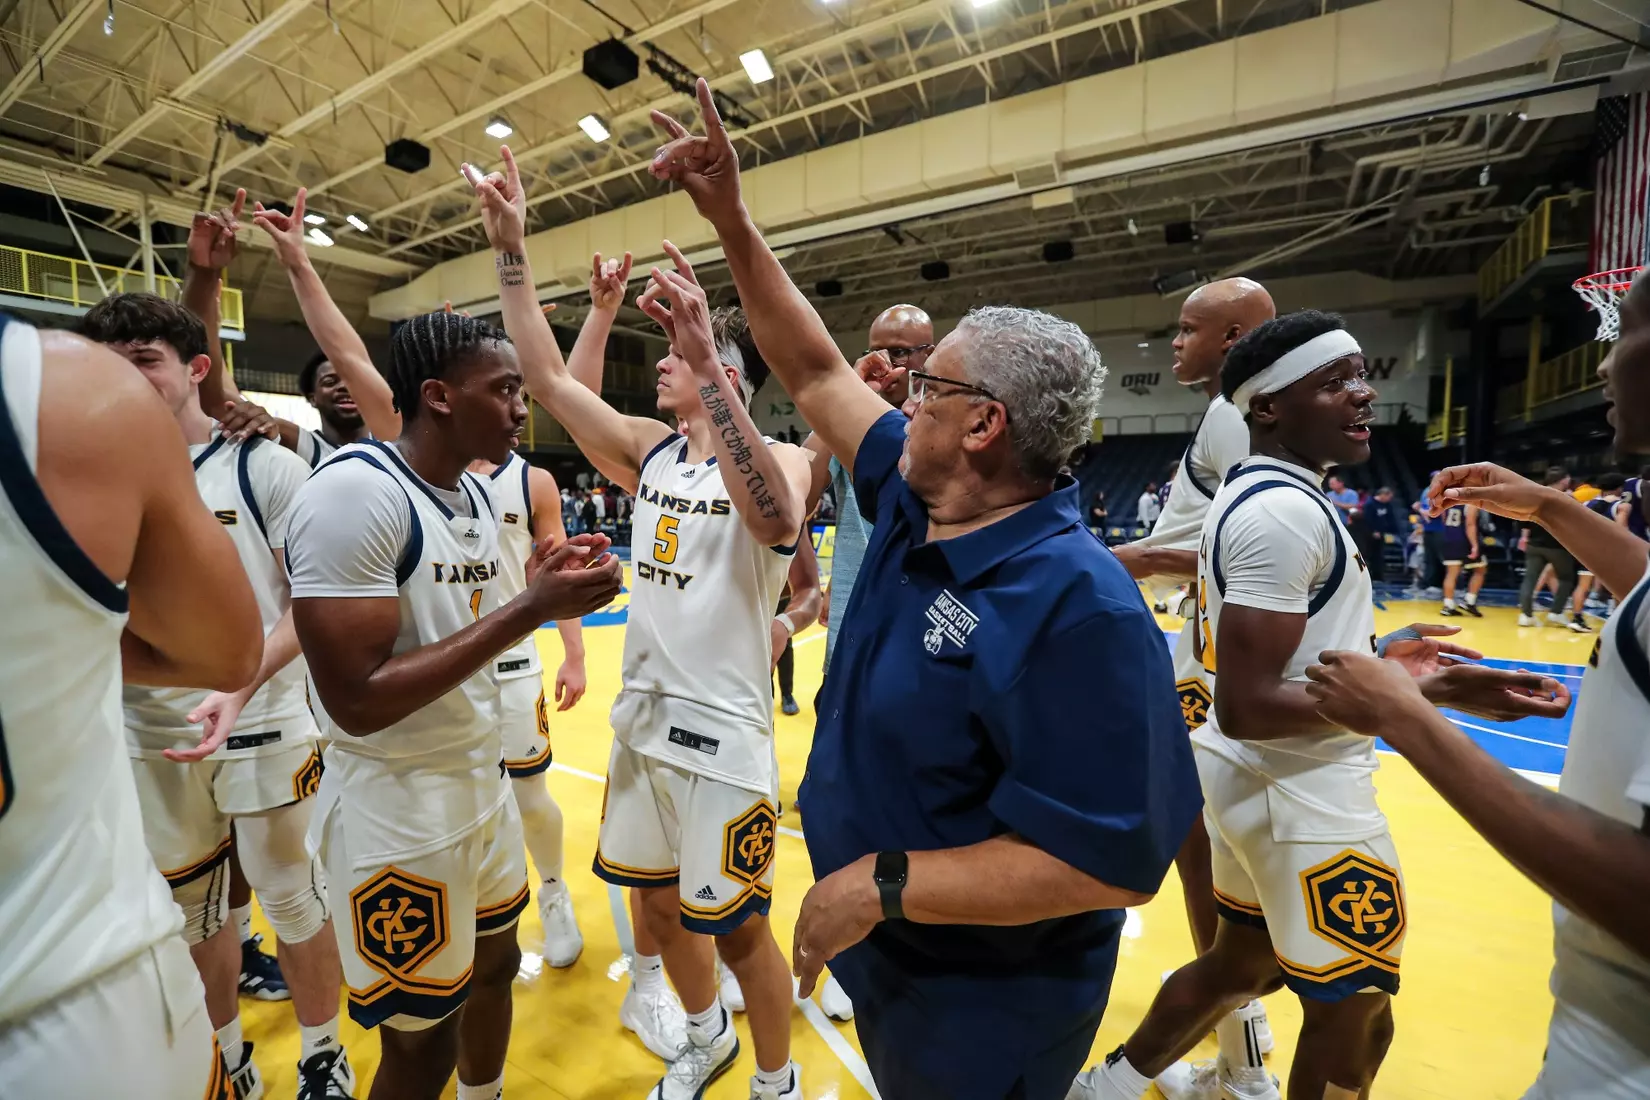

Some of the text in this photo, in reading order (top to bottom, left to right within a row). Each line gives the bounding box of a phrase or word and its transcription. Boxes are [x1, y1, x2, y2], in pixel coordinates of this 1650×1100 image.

[1121, 372, 1161, 387] ORU
[639, 483, 731, 515] KANSAS
[653, 513, 681, 565] 5
[432, 559, 499, 584] KANSA
[637, 561, 694, 590] CITY
[928, 605, 967, 645] BASKETBALL
[934, 593, 978, 635] KANSAS CITY
[695, 893, 717, 901] adidas
